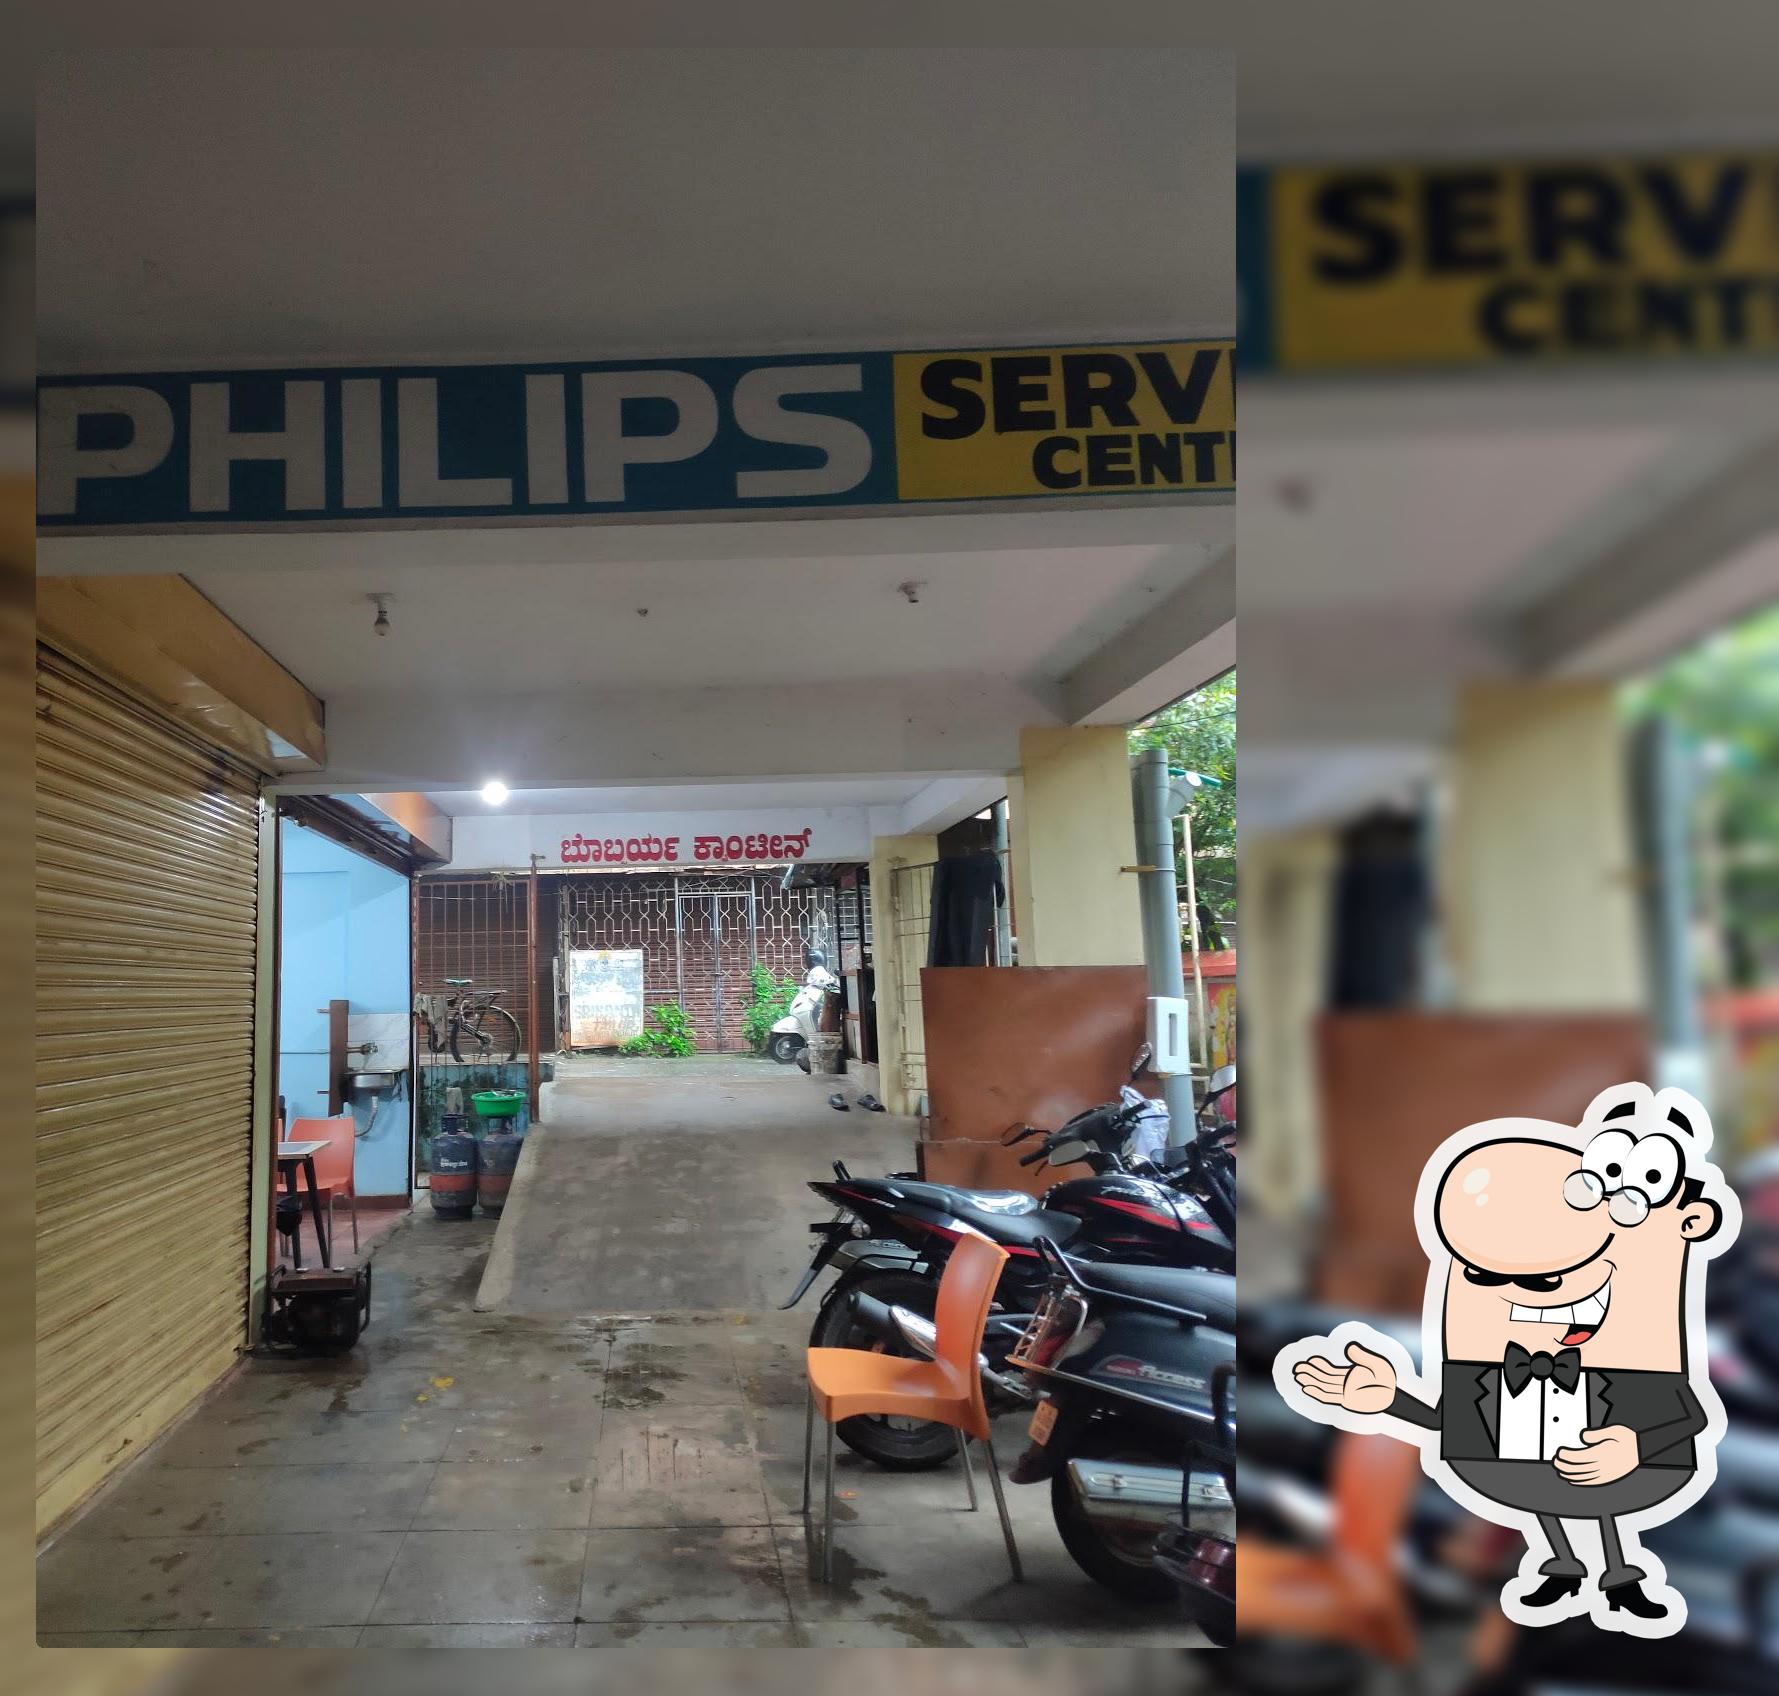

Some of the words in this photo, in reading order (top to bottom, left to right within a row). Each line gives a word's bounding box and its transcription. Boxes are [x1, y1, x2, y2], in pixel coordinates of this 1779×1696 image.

[1308, 158, 1779, 288] SERV
[1480, 274, 1779, 356] CENT
[37, 363, 873, 516] PHILIPS
[919, 348, 1236, 440] SERV
[1031, 431, 1236, 490] CENT
